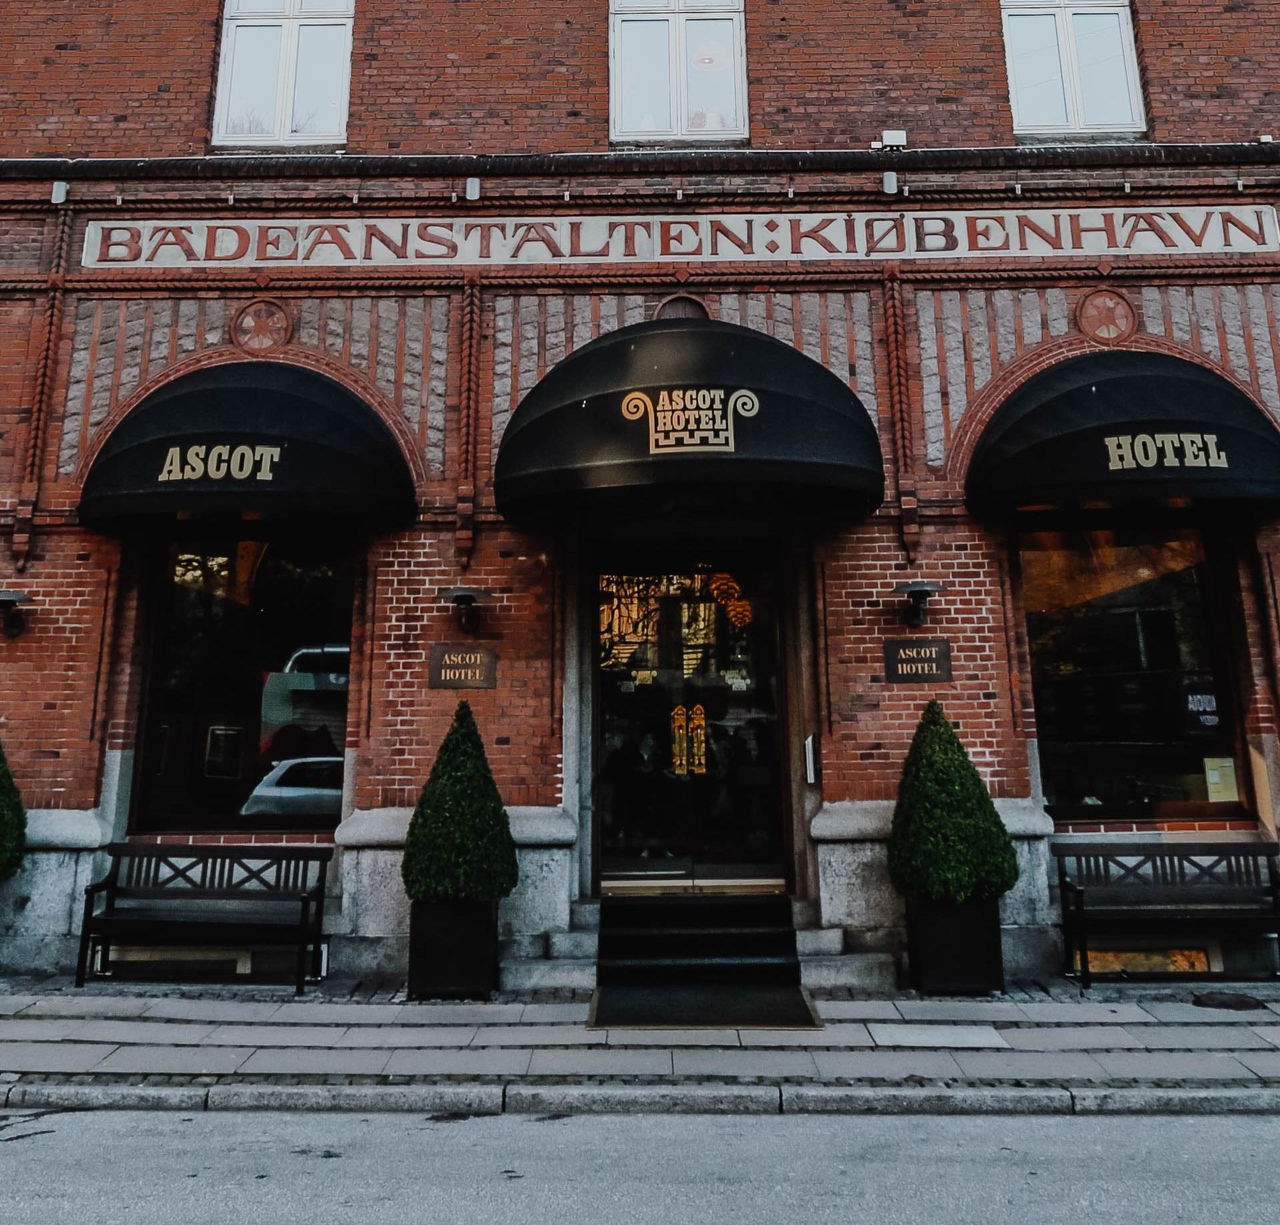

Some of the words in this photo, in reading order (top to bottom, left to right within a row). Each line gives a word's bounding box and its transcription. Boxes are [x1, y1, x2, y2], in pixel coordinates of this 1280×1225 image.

[657, 389, 725, 411] ASCOT
[657, 410, 727, 431] HOTEL
[1104, 433, 1229, 471] HOTEL
[157, 444, 281, 482] ASCOT
[442, 653, 483, 665] ASCOT
[898, 647, 938, 659] ASCOT
[441, 668, 484, 681] HOTEL
[898, 662, 940, 674] HOTEL
